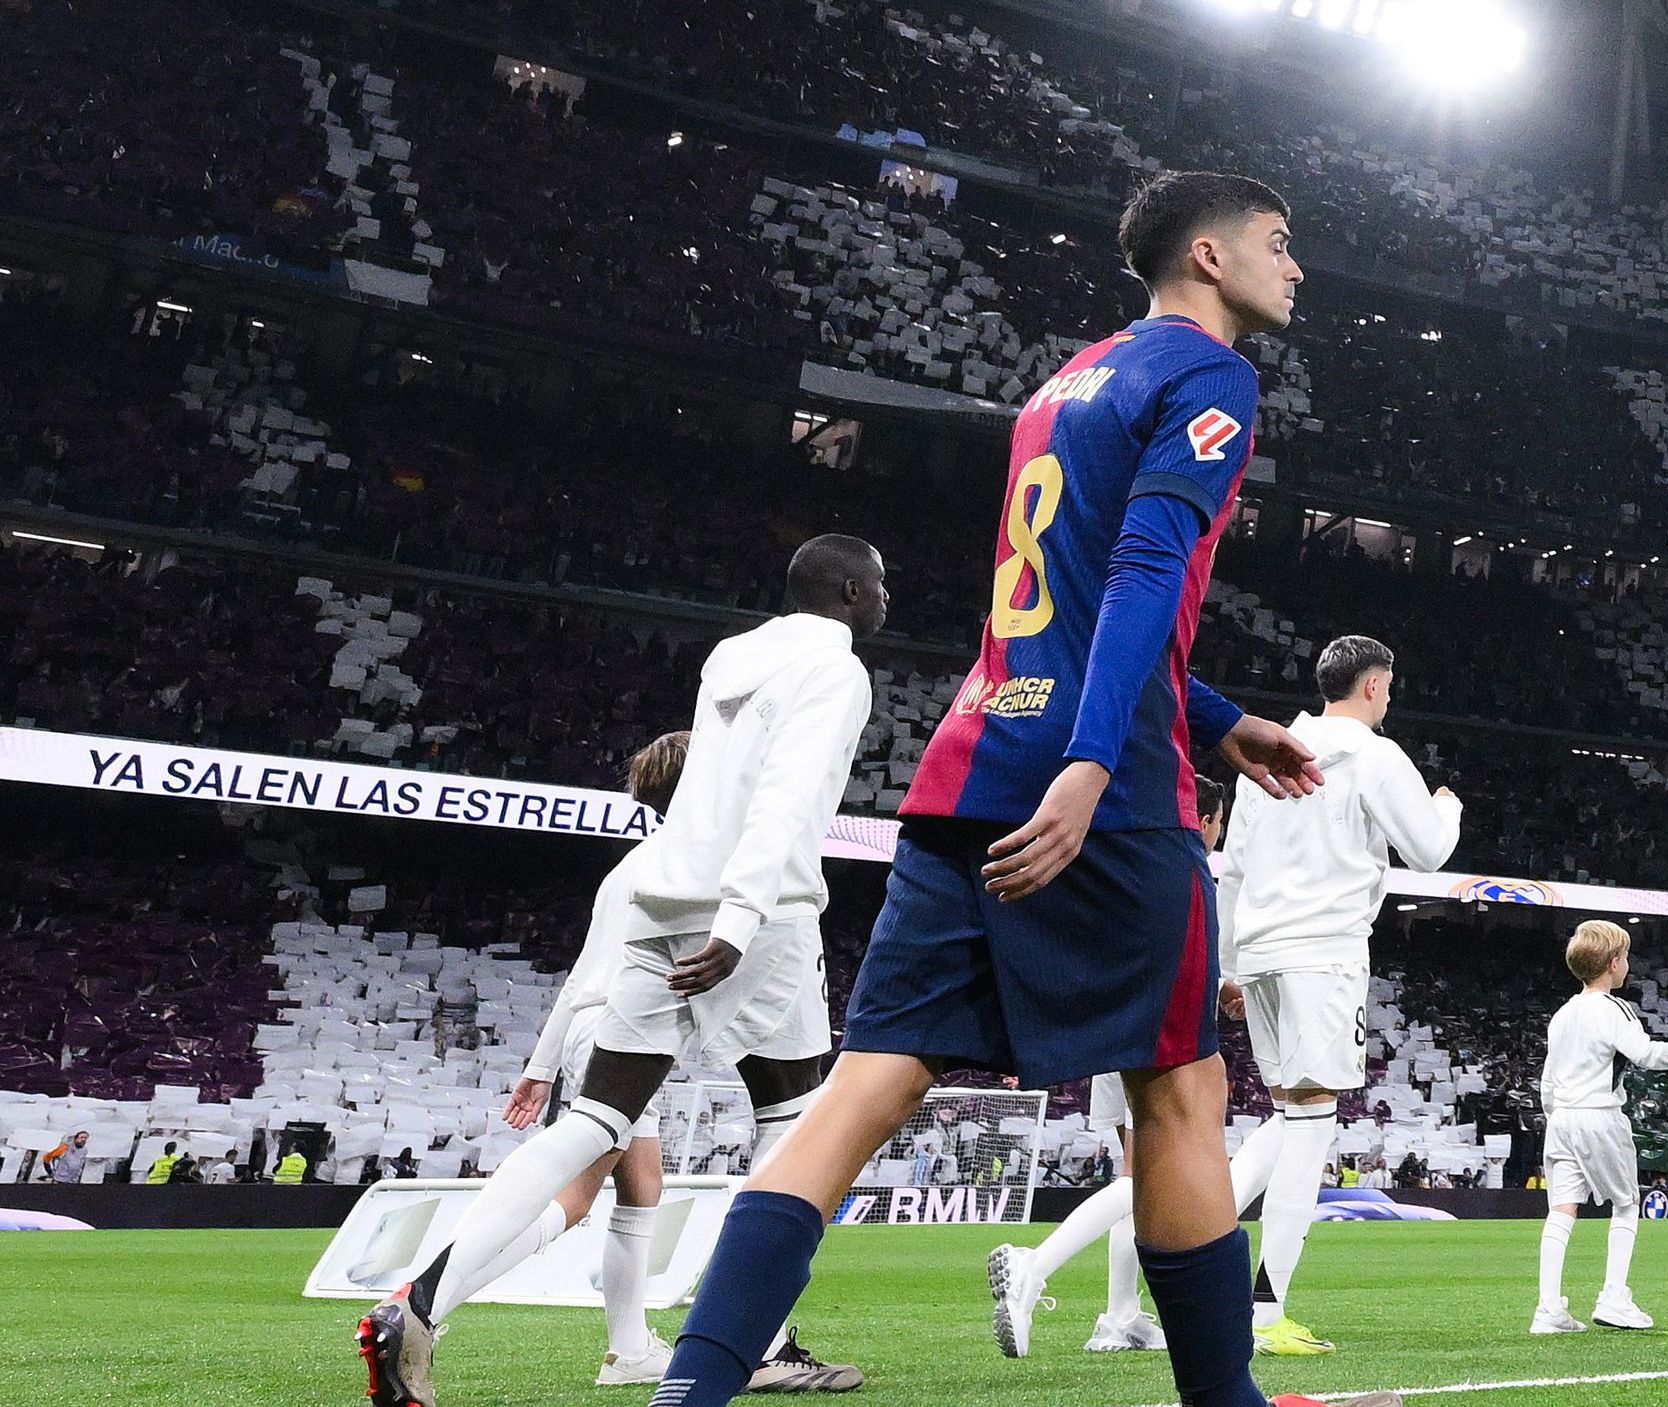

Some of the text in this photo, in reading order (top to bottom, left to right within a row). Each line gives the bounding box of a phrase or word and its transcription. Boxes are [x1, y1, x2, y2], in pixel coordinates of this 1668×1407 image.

[1033, 367, 1116, 413] PEDRI
[992, 453, 1064, 639] 8
[994, 676, 1056, 698] UNHCR
[88, 749, 146, 790] YA
[161, 757, 323, 808] SALEN
[334, 775, 422, 816] LAS
[888, 1187, 1011, 1224] BMW
